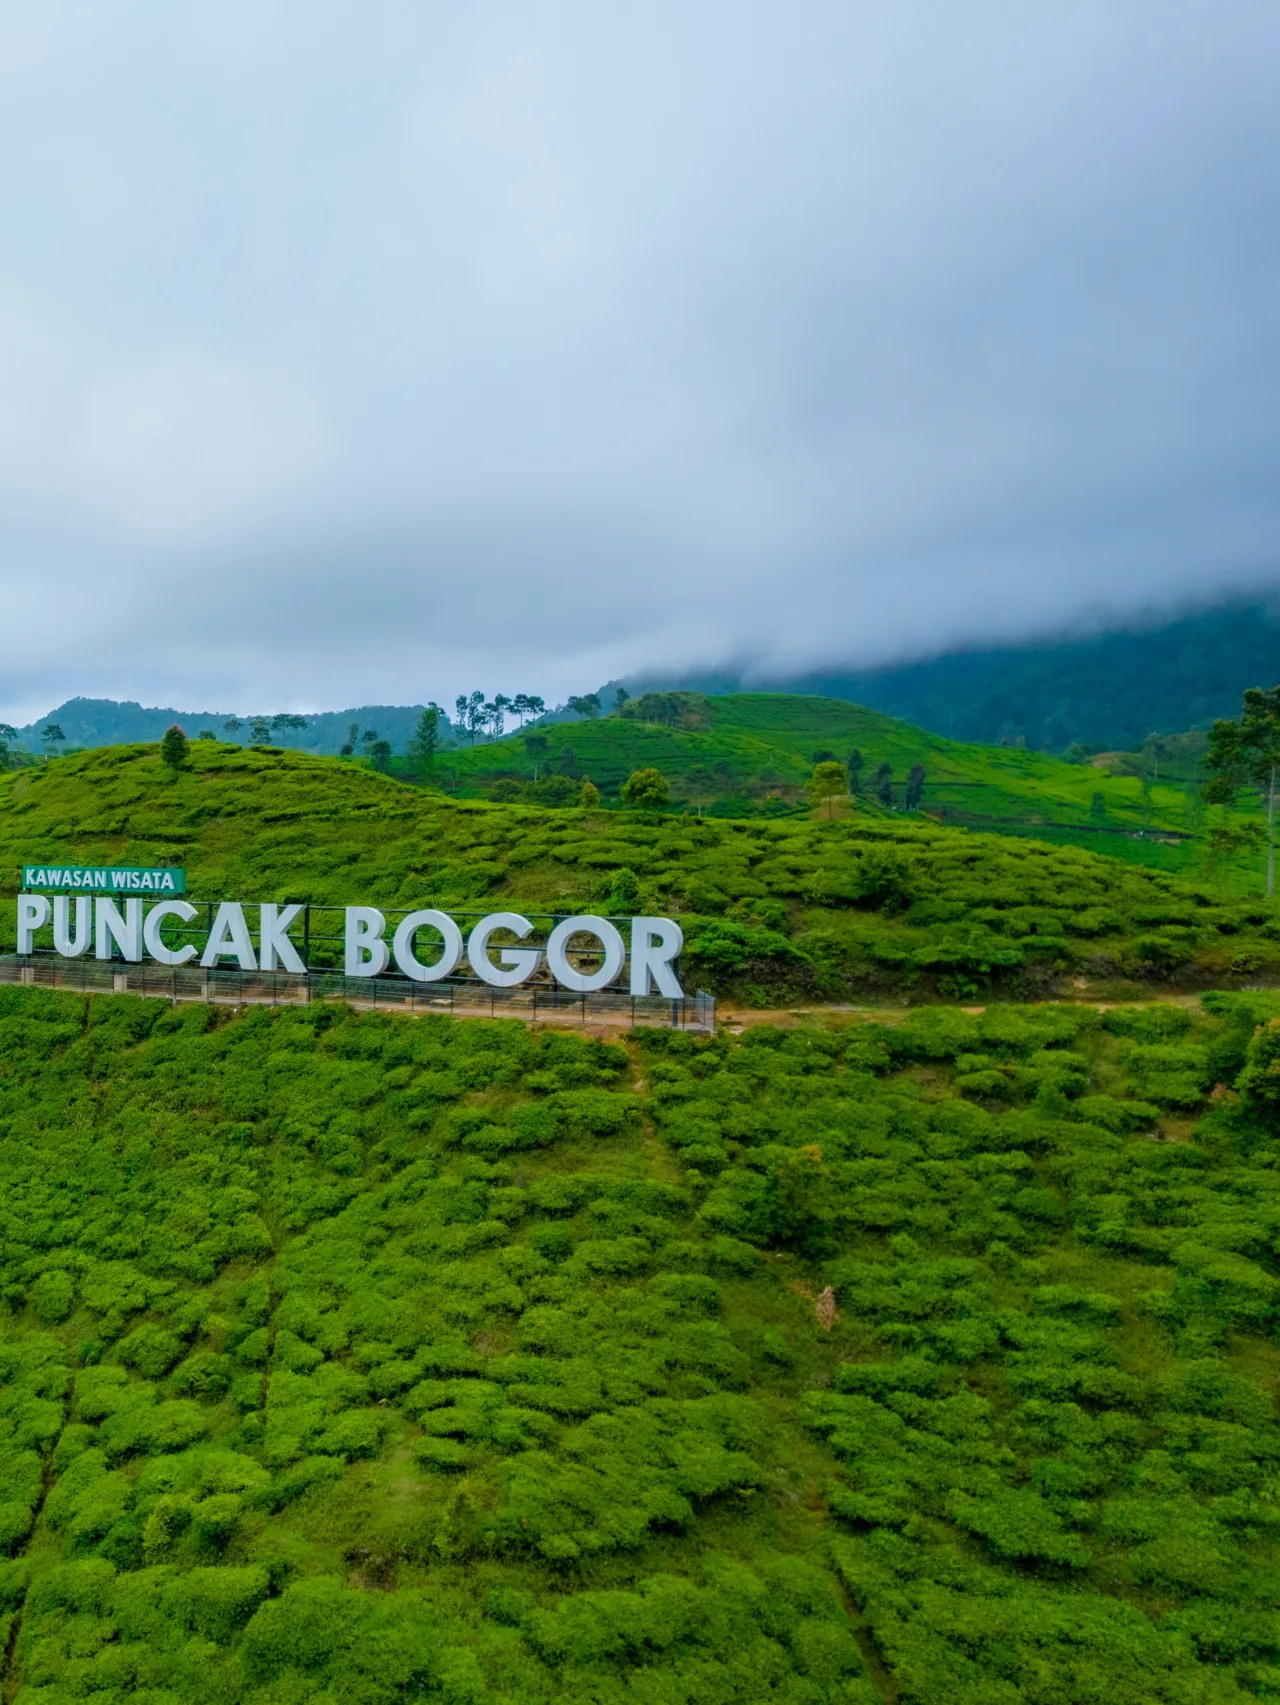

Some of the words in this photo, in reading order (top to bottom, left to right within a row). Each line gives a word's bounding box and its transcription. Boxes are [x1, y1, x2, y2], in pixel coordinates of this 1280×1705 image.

[25, 869, 106, 888] KAWASAN
[111, 870, 174, 890] WISATA
[16, 893, 308, 974] PUNCAK
[344, 906, 685, 998] BOGOR
